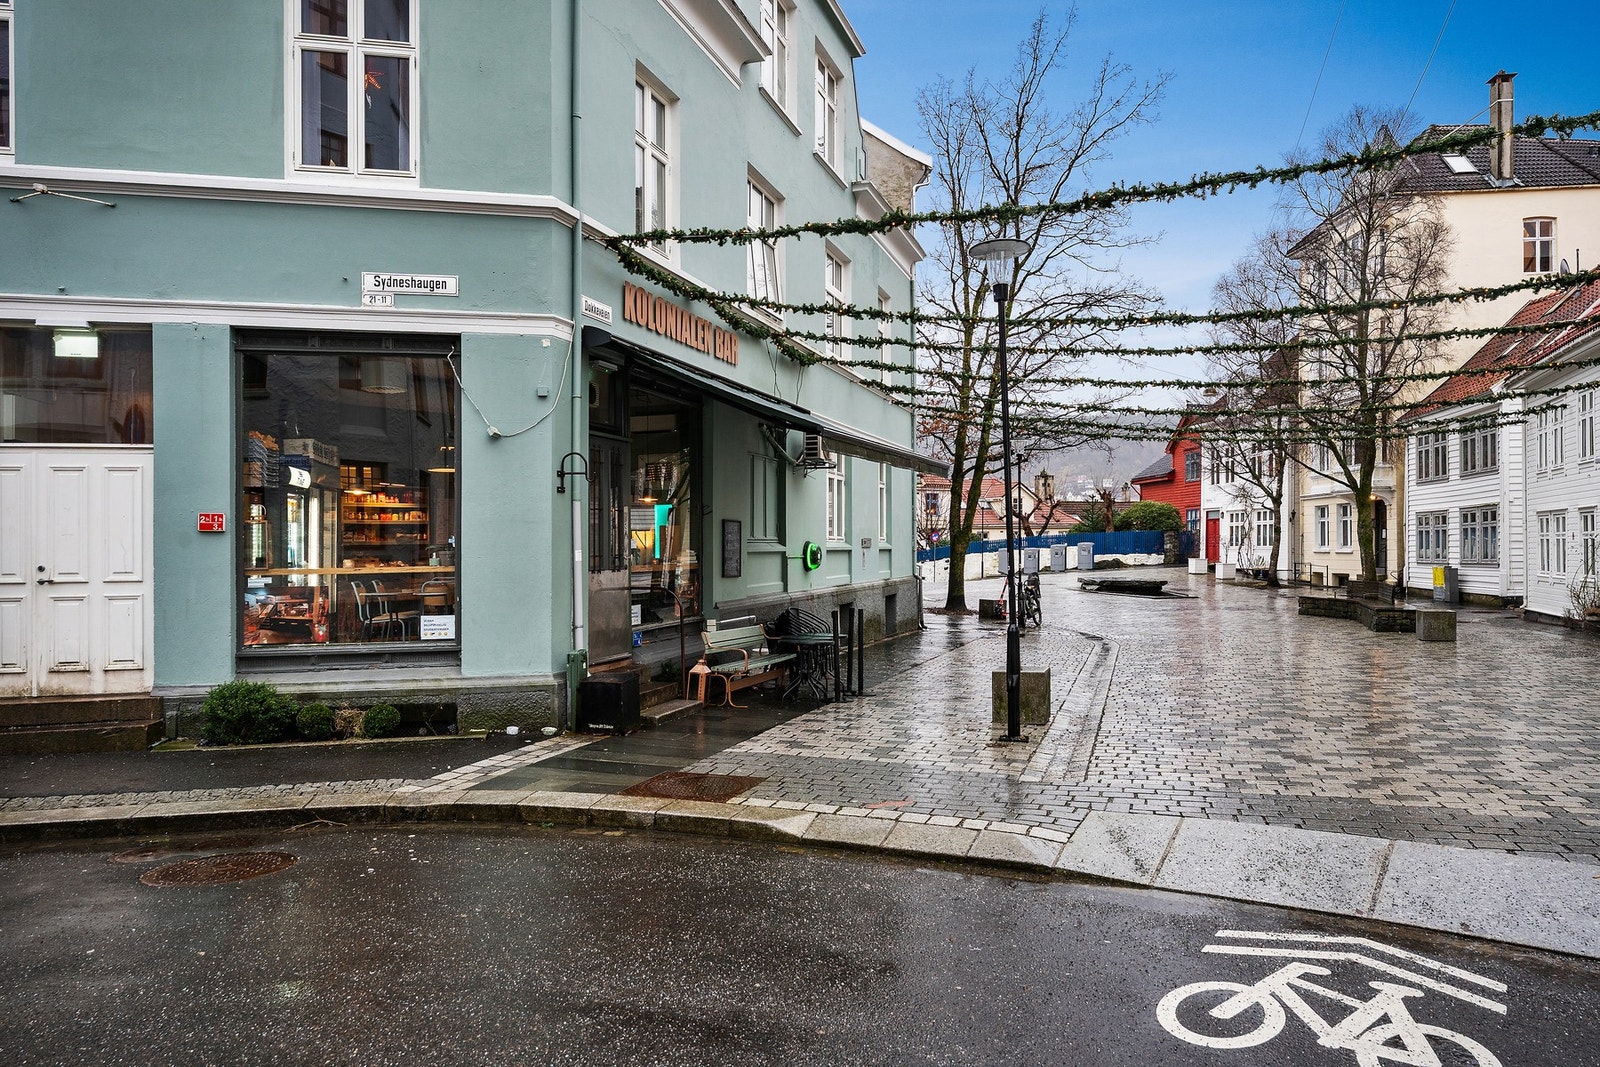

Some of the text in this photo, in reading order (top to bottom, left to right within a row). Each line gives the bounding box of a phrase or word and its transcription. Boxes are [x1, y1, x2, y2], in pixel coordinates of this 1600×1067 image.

[374, 275, 447, 292] Sydneshaugen
[584, 300, 610, 320] Dokkeveien
[624, 280, 739, 366] KOLONIALEN BAR
